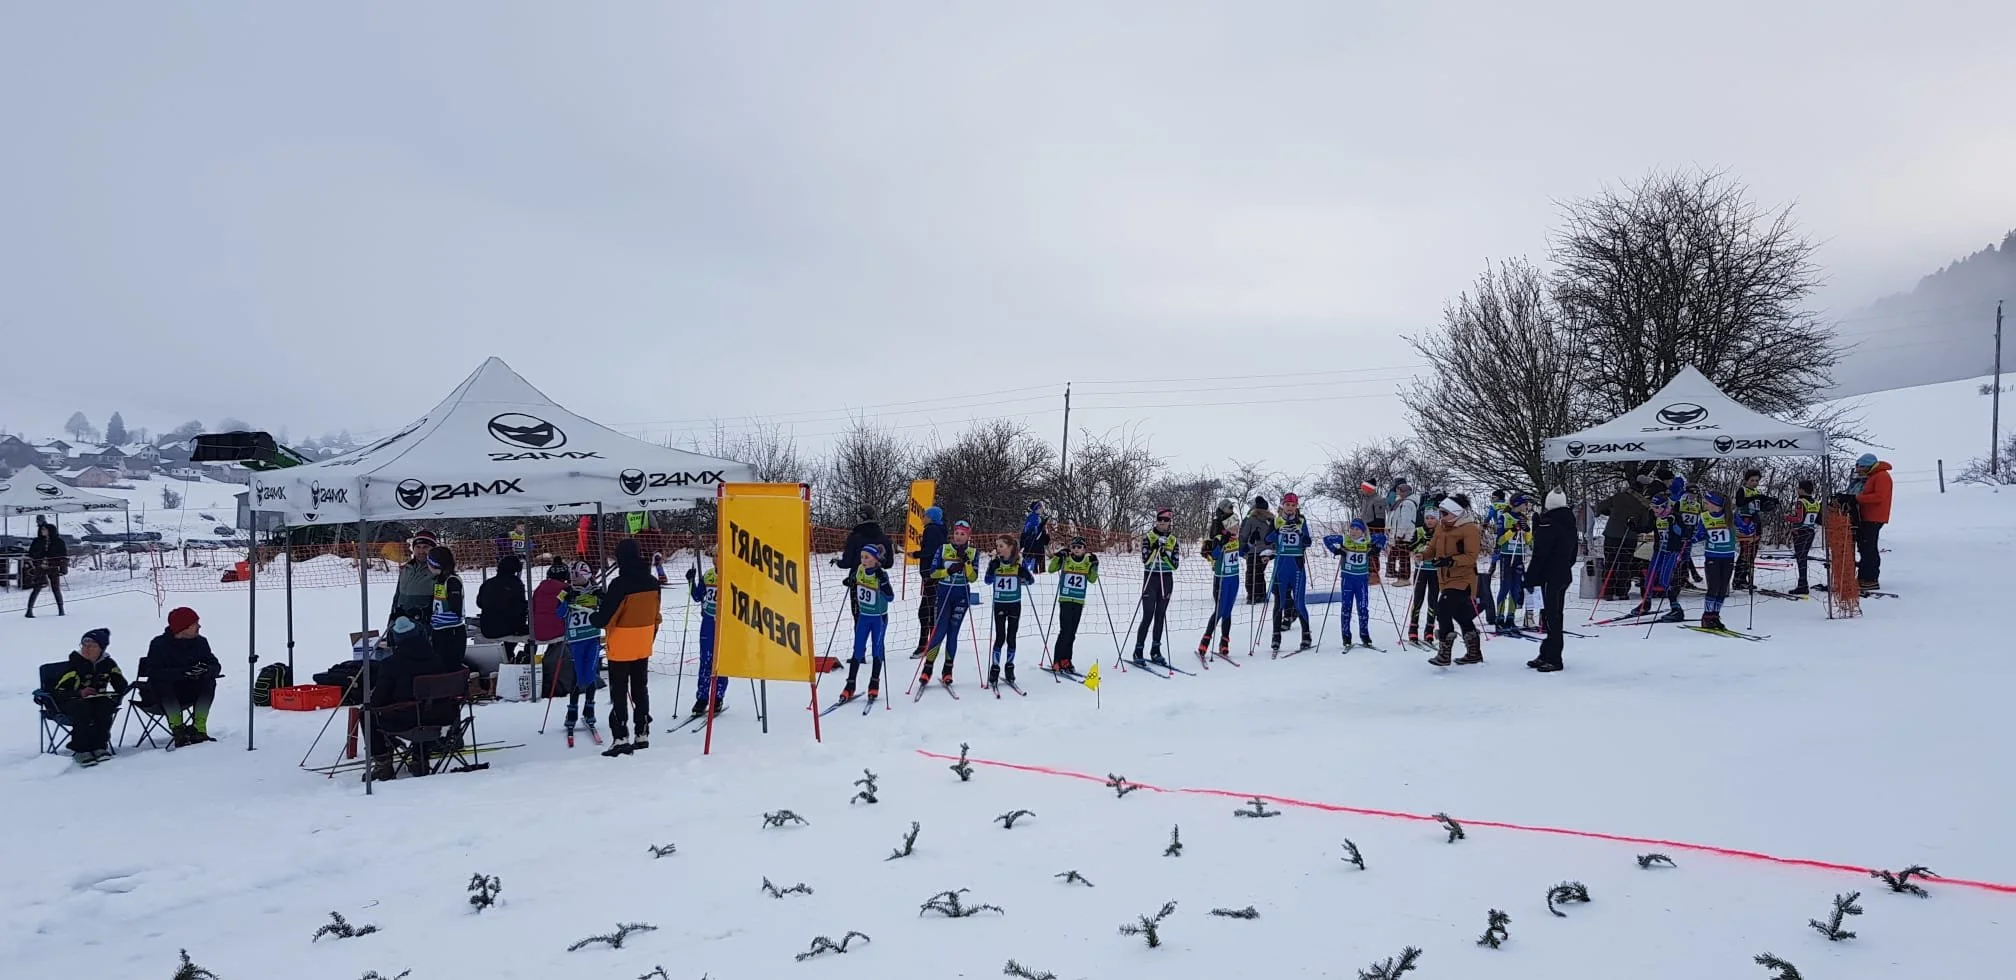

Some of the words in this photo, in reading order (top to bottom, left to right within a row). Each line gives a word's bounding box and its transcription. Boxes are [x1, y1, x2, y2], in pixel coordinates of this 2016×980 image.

[1587, 442, 1646, 453] 24MX
[1736, 439, 1800, 449] 24MX
[488, 452, 607, 461] 24MX
[649, 470, 725, 488] 24MX
[264, 486, 286, 500] 24MX
[320, 488, 348, 503] 24MX
[431, 478, 524, 500] 24MX
[1684, 514, 1694, 524] 24
[1282, 534, 1296, 544] 45
[1711, 530, 1726, 542] 51
[1228, 552, 1238, 564] 44
[998, 577, 1012, 590] 41
[1068, 575, 1082, 588] 42
[859, 588, 872, 602] 39
[572, 612, 588, 626] 37
